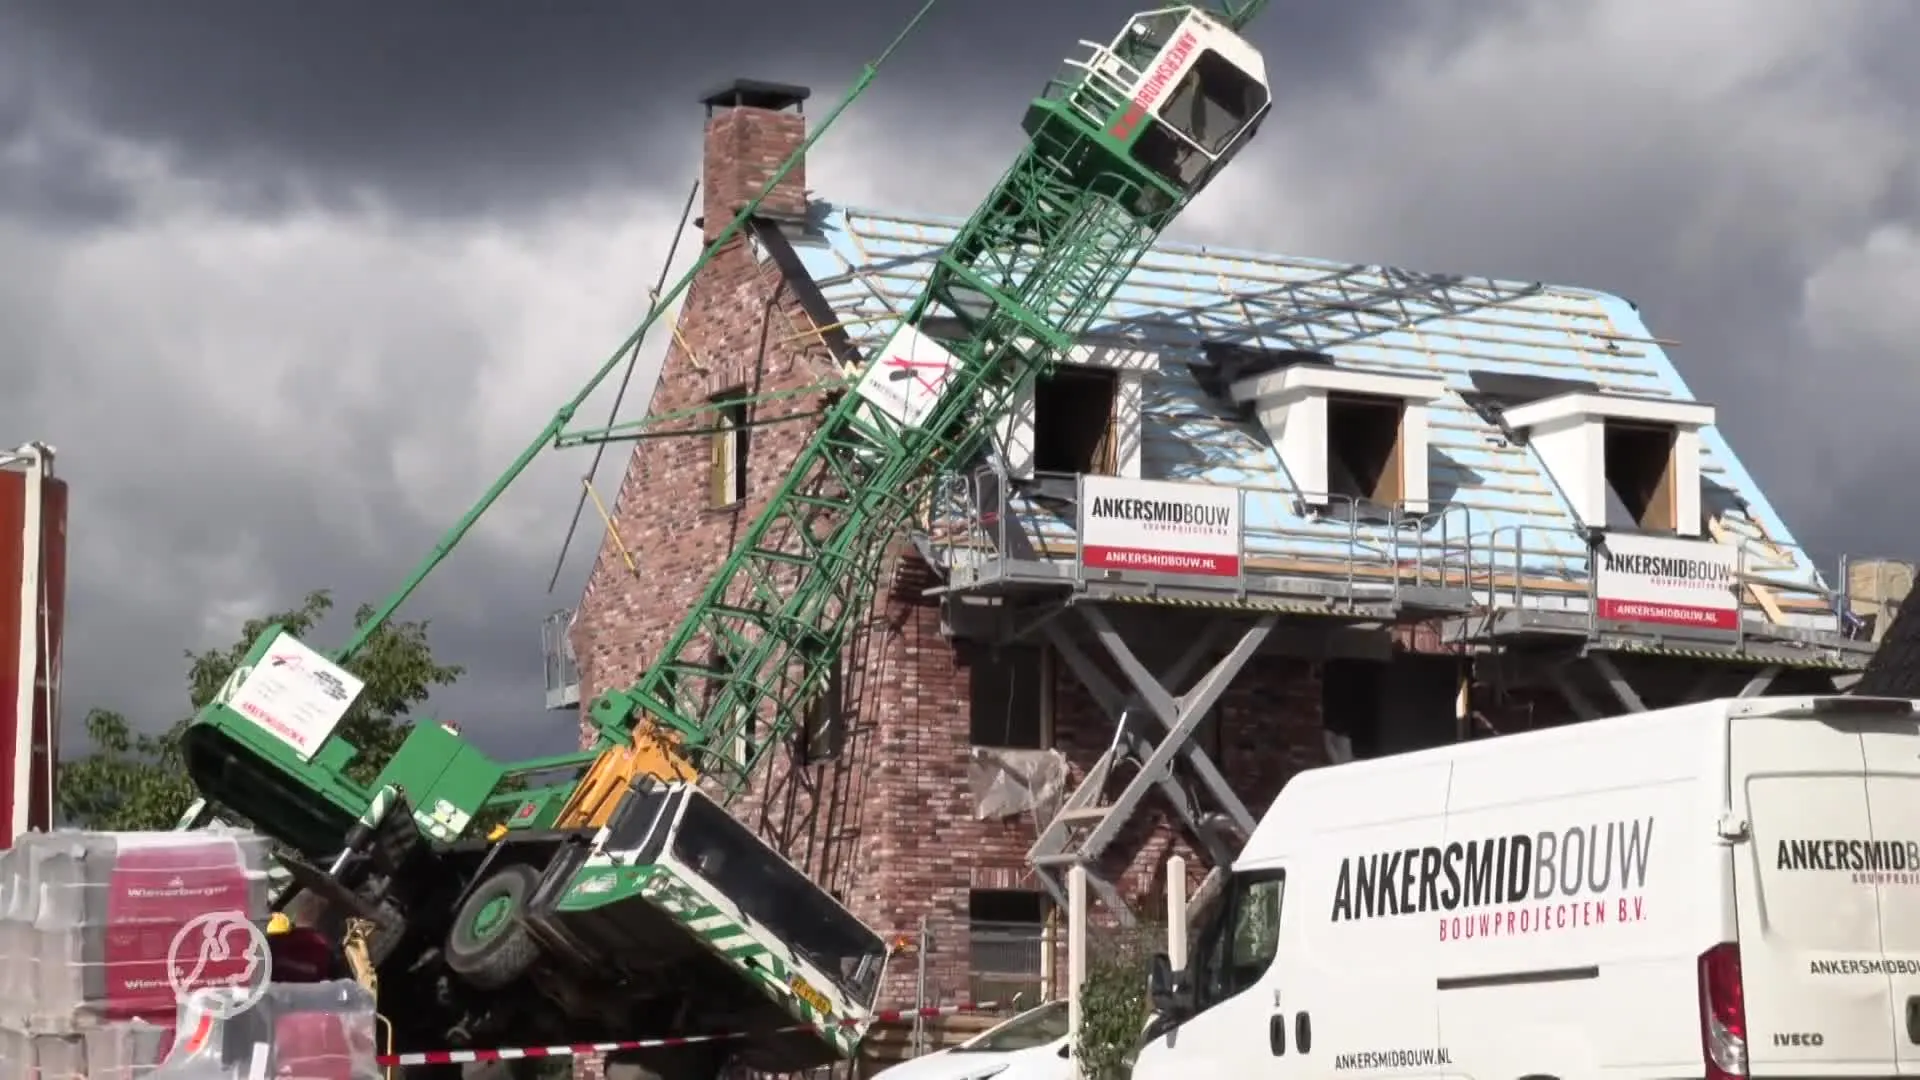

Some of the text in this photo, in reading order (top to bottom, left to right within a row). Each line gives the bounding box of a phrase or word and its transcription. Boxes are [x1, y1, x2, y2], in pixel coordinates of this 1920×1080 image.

[1092, 496, 1230, 526] ANKERSMIDBOUW
[1105, 551, 1217, 569] ANKERSMIDBOUW.NL
[1605, 553, 1731, 581] ANKERSMIDBOUW
[1616, 604, 1718, 622] ANKERSMIDBOUW.NL
[1331, 816, 1654, 922] ANKERSMIDBOUW
[1439, 896, 1648, 942] BOUWPROJECTEN B.V.
[1773, 1032, 1824, 1047] IVECO
[1336, 1048, 1453, 1071] ANKERSMIDBOUW.NL
